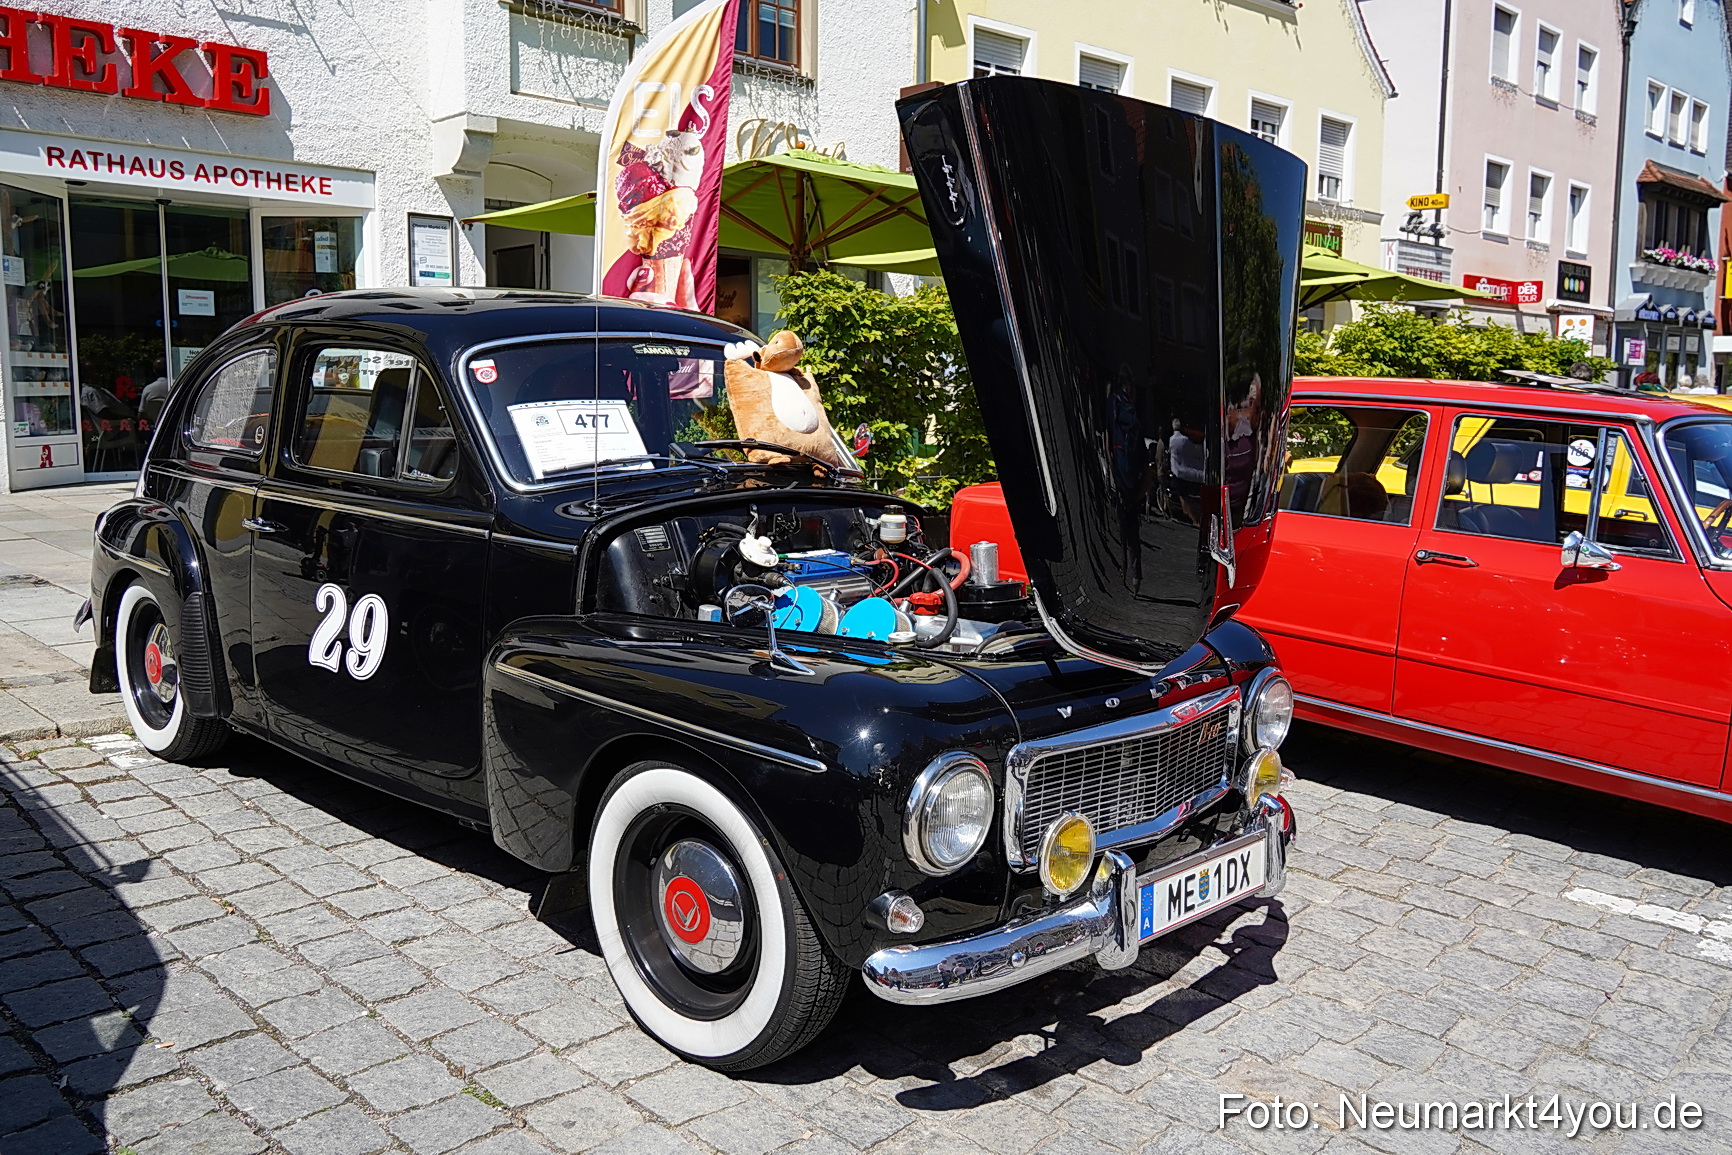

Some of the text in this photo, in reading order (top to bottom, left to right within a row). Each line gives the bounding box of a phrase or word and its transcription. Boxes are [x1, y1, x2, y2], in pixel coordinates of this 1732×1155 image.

[632, 82, 714, 139] EIS
[46, 146, 333, 196] RATHAUS APOTHEKE
[1410, 197, 1429, 208] KINO
[1518, 282, 1538, 295] DER
[575, 413, 609, 429] 477
[309, 583, 389, 680] 29
[1057, 673, 1211, 719] VOLVO
[1168, 850, 1251, 922] ME 1DX
[1143, 917, 1151, 930] A
